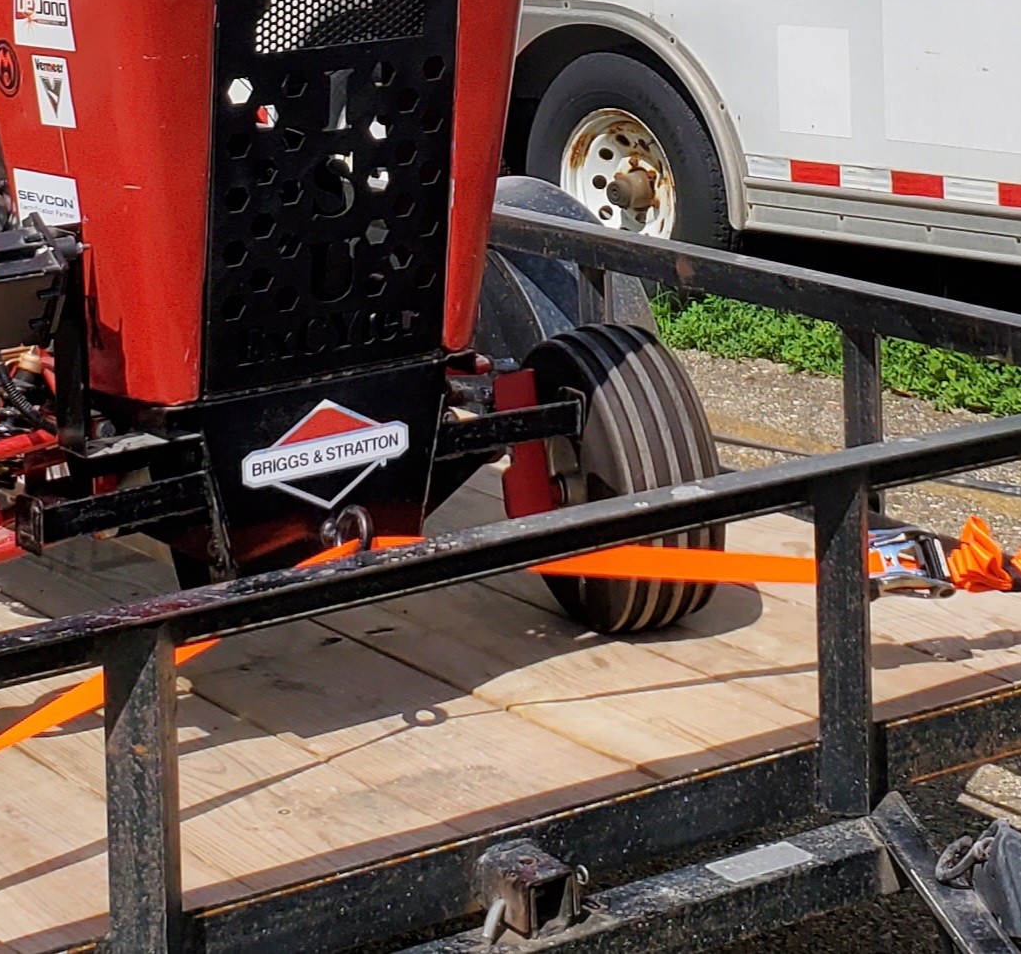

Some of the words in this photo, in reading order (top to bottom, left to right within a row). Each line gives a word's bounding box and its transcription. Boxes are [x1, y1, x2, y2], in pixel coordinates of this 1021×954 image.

[18, 189, 74, 209] SEVCON
[252, 452, 309, 477] BRIGGS
[313, 449, 324, 464] &
[325, 432, 399, 462] STRATTON
